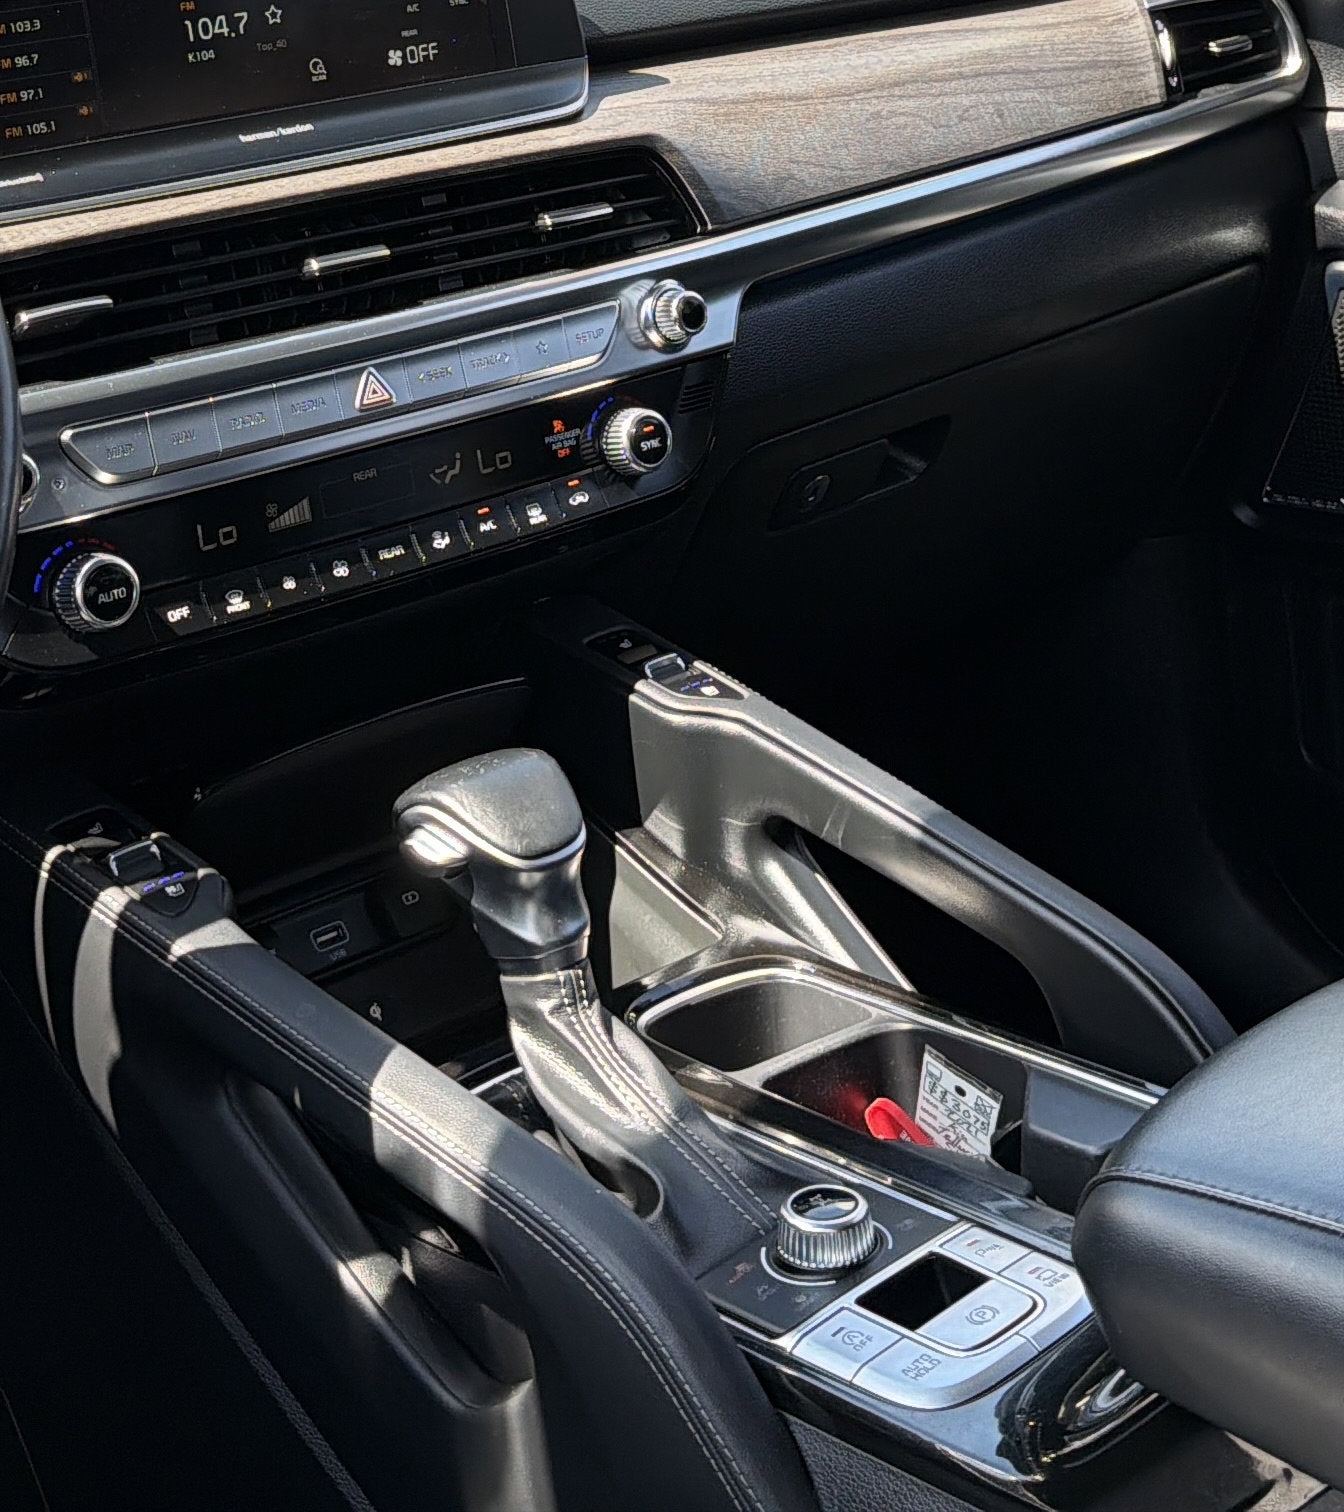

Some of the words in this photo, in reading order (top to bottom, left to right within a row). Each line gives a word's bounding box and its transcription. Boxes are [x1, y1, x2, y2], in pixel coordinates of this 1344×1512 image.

[179, 0, 196, 12] FM
[9, 19, 42, 34] 103.3
[184, 11, 249, 43] 104.7
[14, 53, 40, 69] 96.7
[187, 49, 216, 64] K104
[405, 42, 439, 65] OFF
[0, 92, 18, 105] FM
[19, 87, 44, 102] 97.1
[5, 125, 24, 139] FM
[26, 120, 57, 136] 105.1
[574, 327, 605, 344] SETUP
[640, 437, 663, 452] SYNC
[352, 467, 378, 483] REAR
[478, 519, 498, 533] A/C
[377, 544, 406, 561] REAR
[96, 586, 127, 605] AUTO
[165, 605, 192, 623] OFF
[852, 1334, 874, 1352] OFF
[901, 1353, 932, 1377] AUTO
[909, 1357, 943, 1382] HOLD
